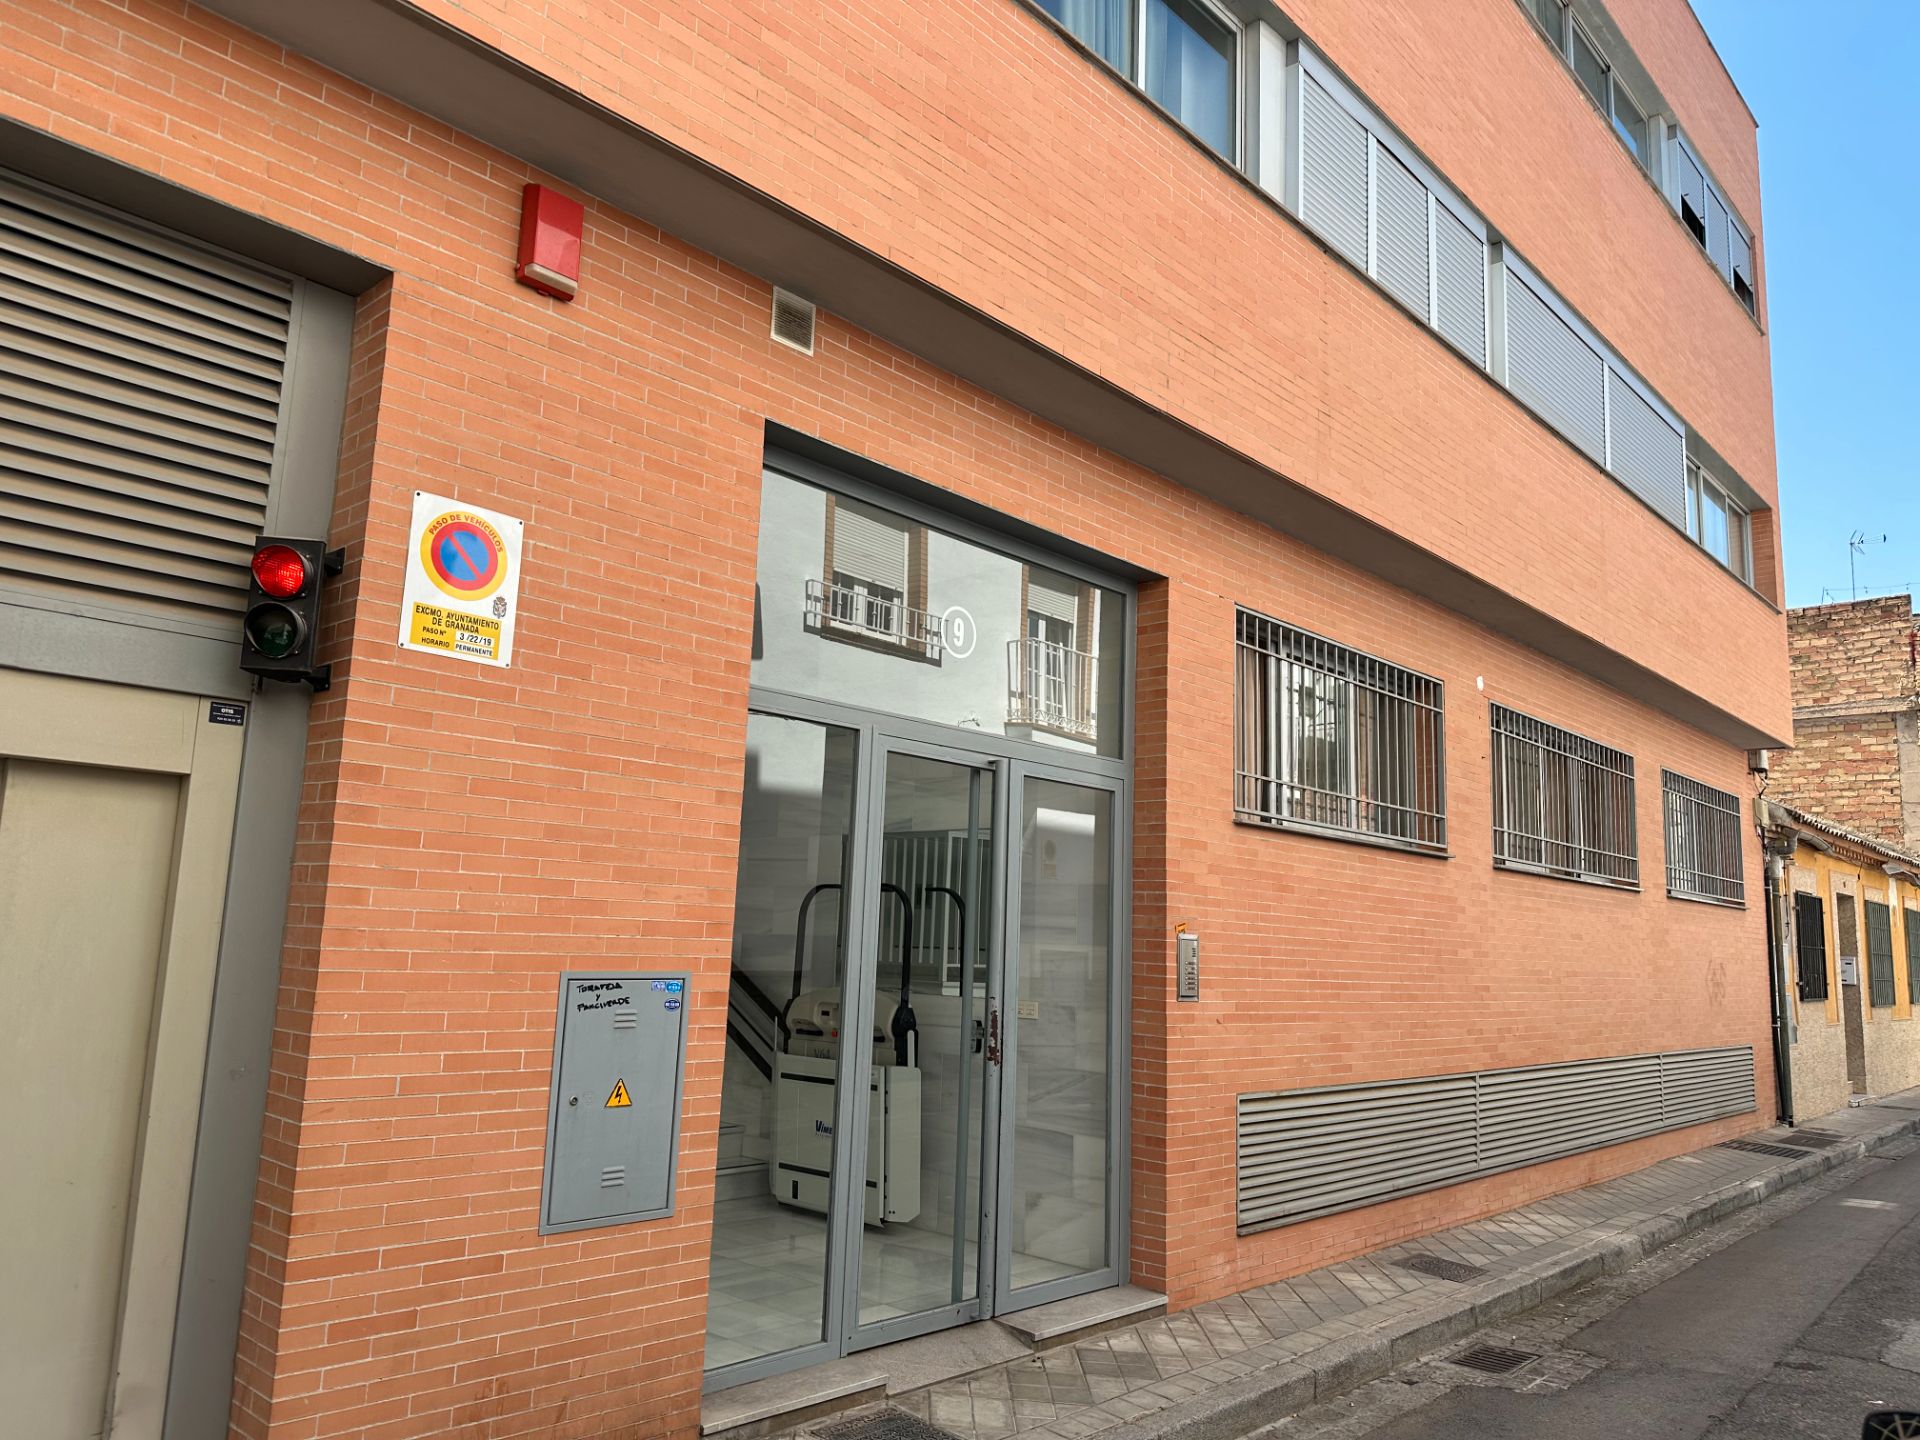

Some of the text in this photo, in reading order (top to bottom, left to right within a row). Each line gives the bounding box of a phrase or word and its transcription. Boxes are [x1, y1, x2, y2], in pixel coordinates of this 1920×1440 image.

[428, 513, 503, 552] PASO DE VEHÍCULOS
[415, 605, 500, 631] EXCMO. AYUNTAMIENTO
[431, 617, 480, 634] DE GRANADA
[422, 626, 439, 635] PASO
[953, 617, 965, 647] 9
[421, 636, 493, 657] HORARIO PERMANENTE
